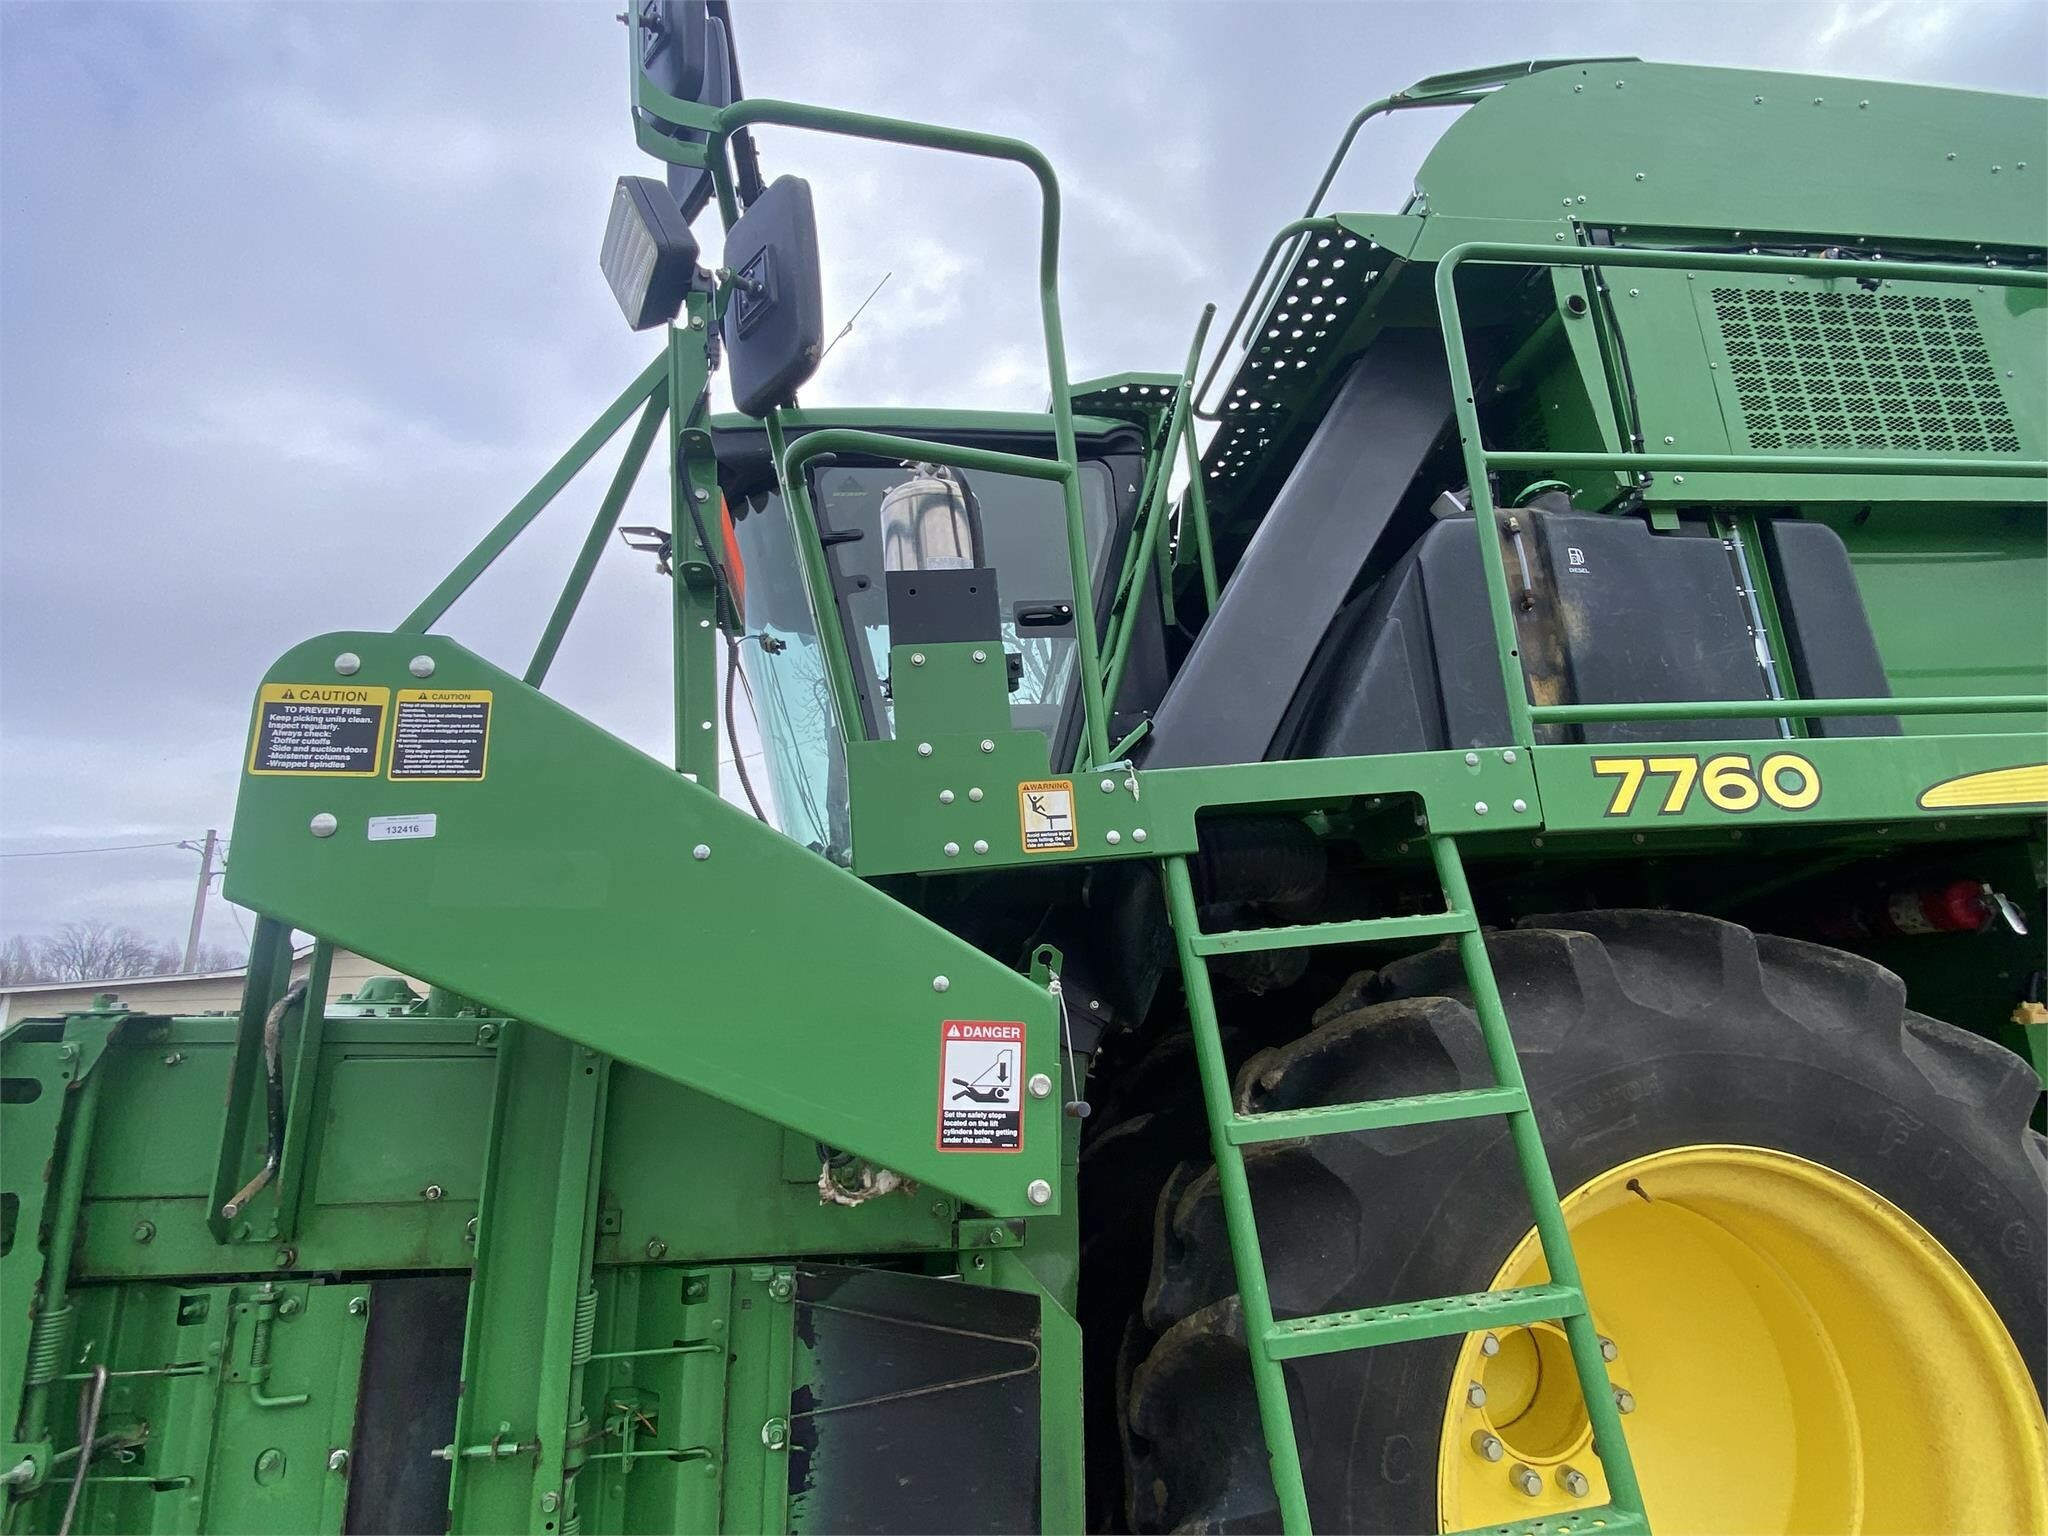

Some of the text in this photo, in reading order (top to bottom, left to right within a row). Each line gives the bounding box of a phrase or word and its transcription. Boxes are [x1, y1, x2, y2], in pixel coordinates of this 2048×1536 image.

[300, 690, 368, 701] CAUTION
[299, 706, 340, 714] PREVENT
[270, 714, 291, 722] Keep
[293, 715, 324, 723] picking
[326, 715, 346, 723] units
[268, 722, 340, 731] Inspect regularly.
[272, 730, 302, 738] Always
[1030, 782, 1069, 790] WARNING
[1591, 751, 1821, 817] 7760
[386, 825, 420, 834] 132416
[963, 1026, 1020, 1038] DANGER
[968, 1112, 987, 1120] safety
[988, 1112, 1006, 1120] stops
[995, 1129, 1018, 1137] getting
